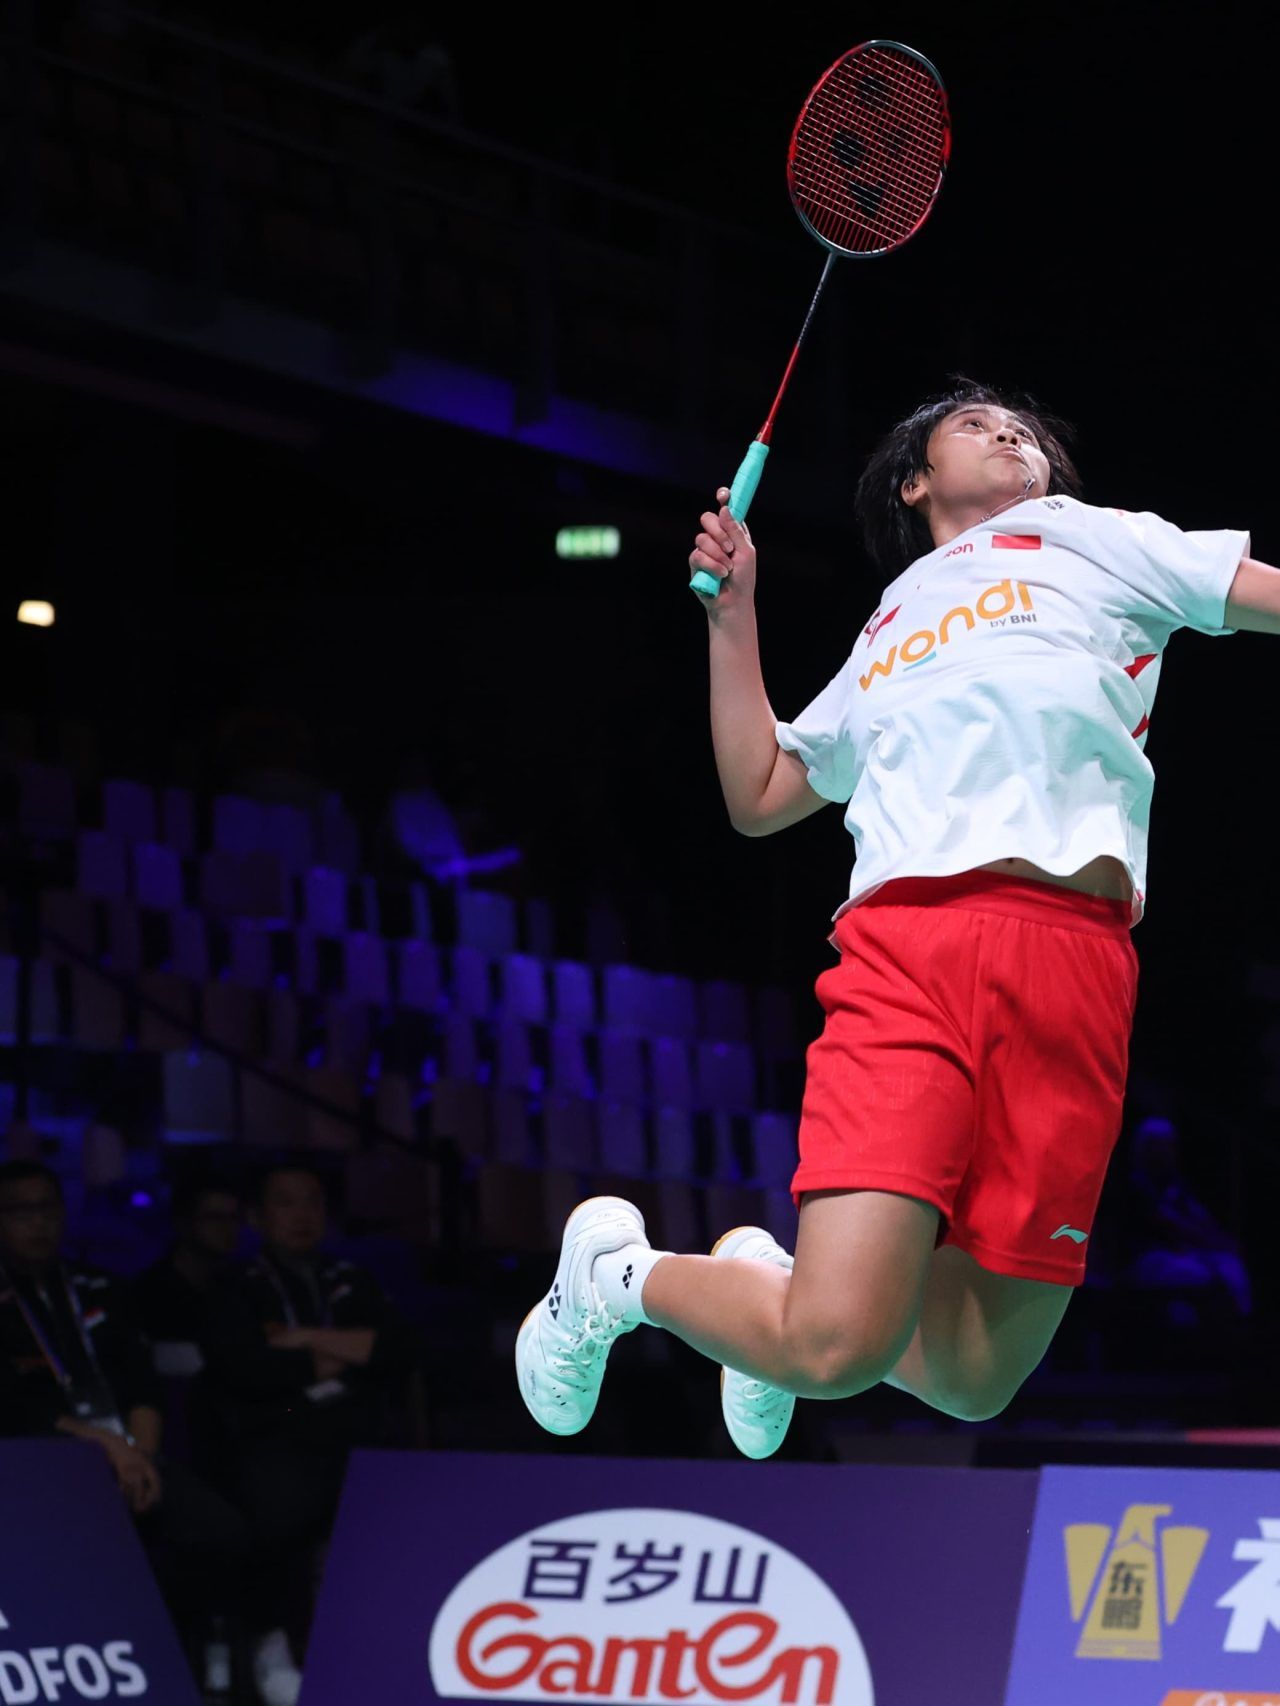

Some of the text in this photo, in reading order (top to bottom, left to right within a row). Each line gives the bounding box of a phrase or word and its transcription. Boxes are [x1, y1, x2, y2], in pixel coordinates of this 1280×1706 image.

[990, 613, 1037, 628] by BNI
[523, 1539, 770, 1604] 百岁山
